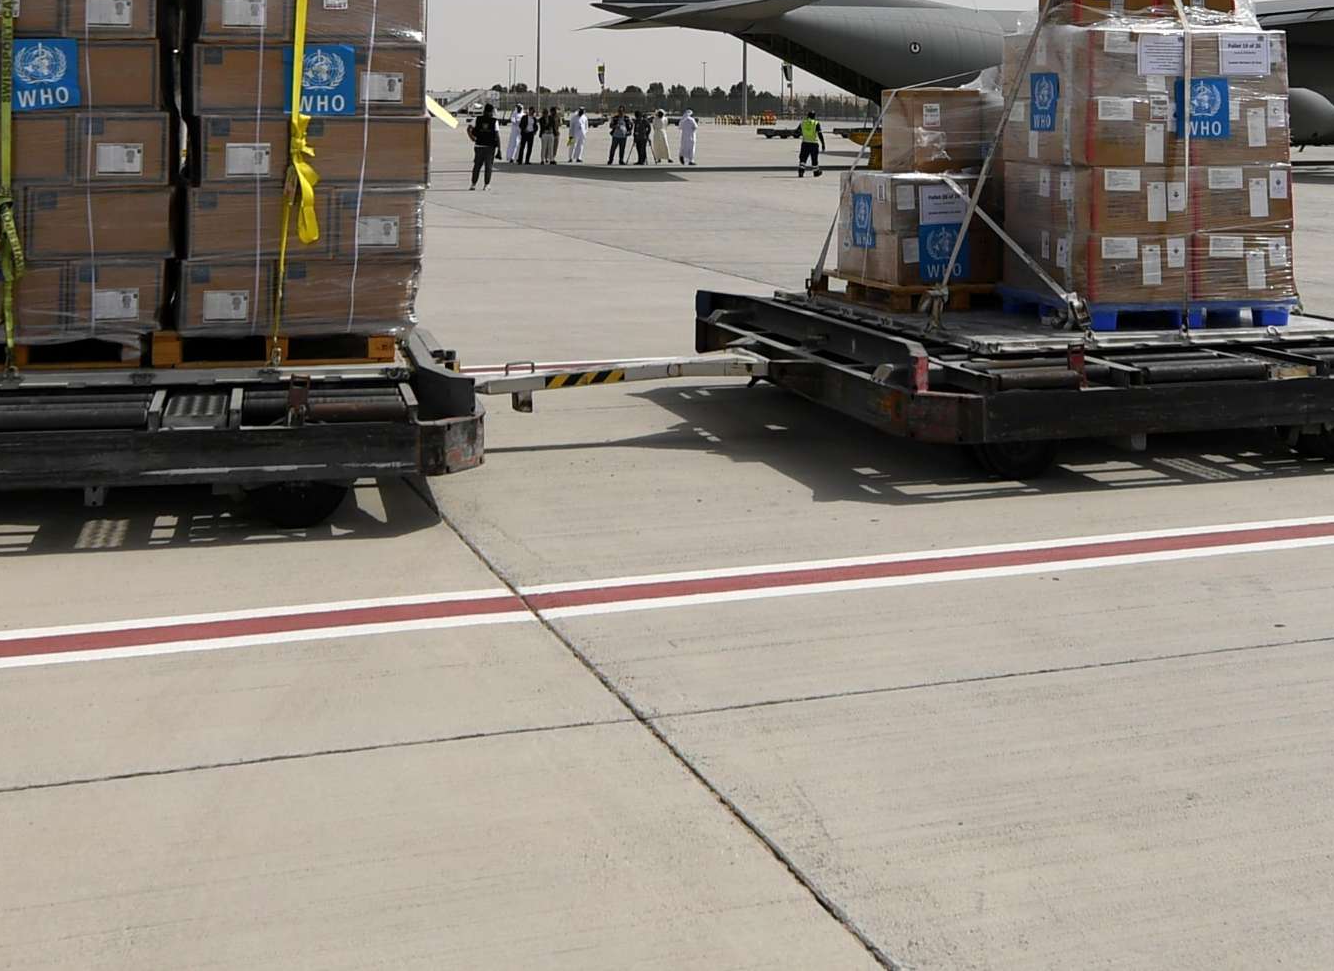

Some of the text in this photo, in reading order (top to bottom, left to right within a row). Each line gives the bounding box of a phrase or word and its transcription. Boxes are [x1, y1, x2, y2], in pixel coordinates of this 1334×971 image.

[1, 25, 13, 104] SWISSPORT
[17, 87, 70, 108] WHO
[298, 93, 346, 113] WHO
[1033, 114, 1051, 128] WHO
